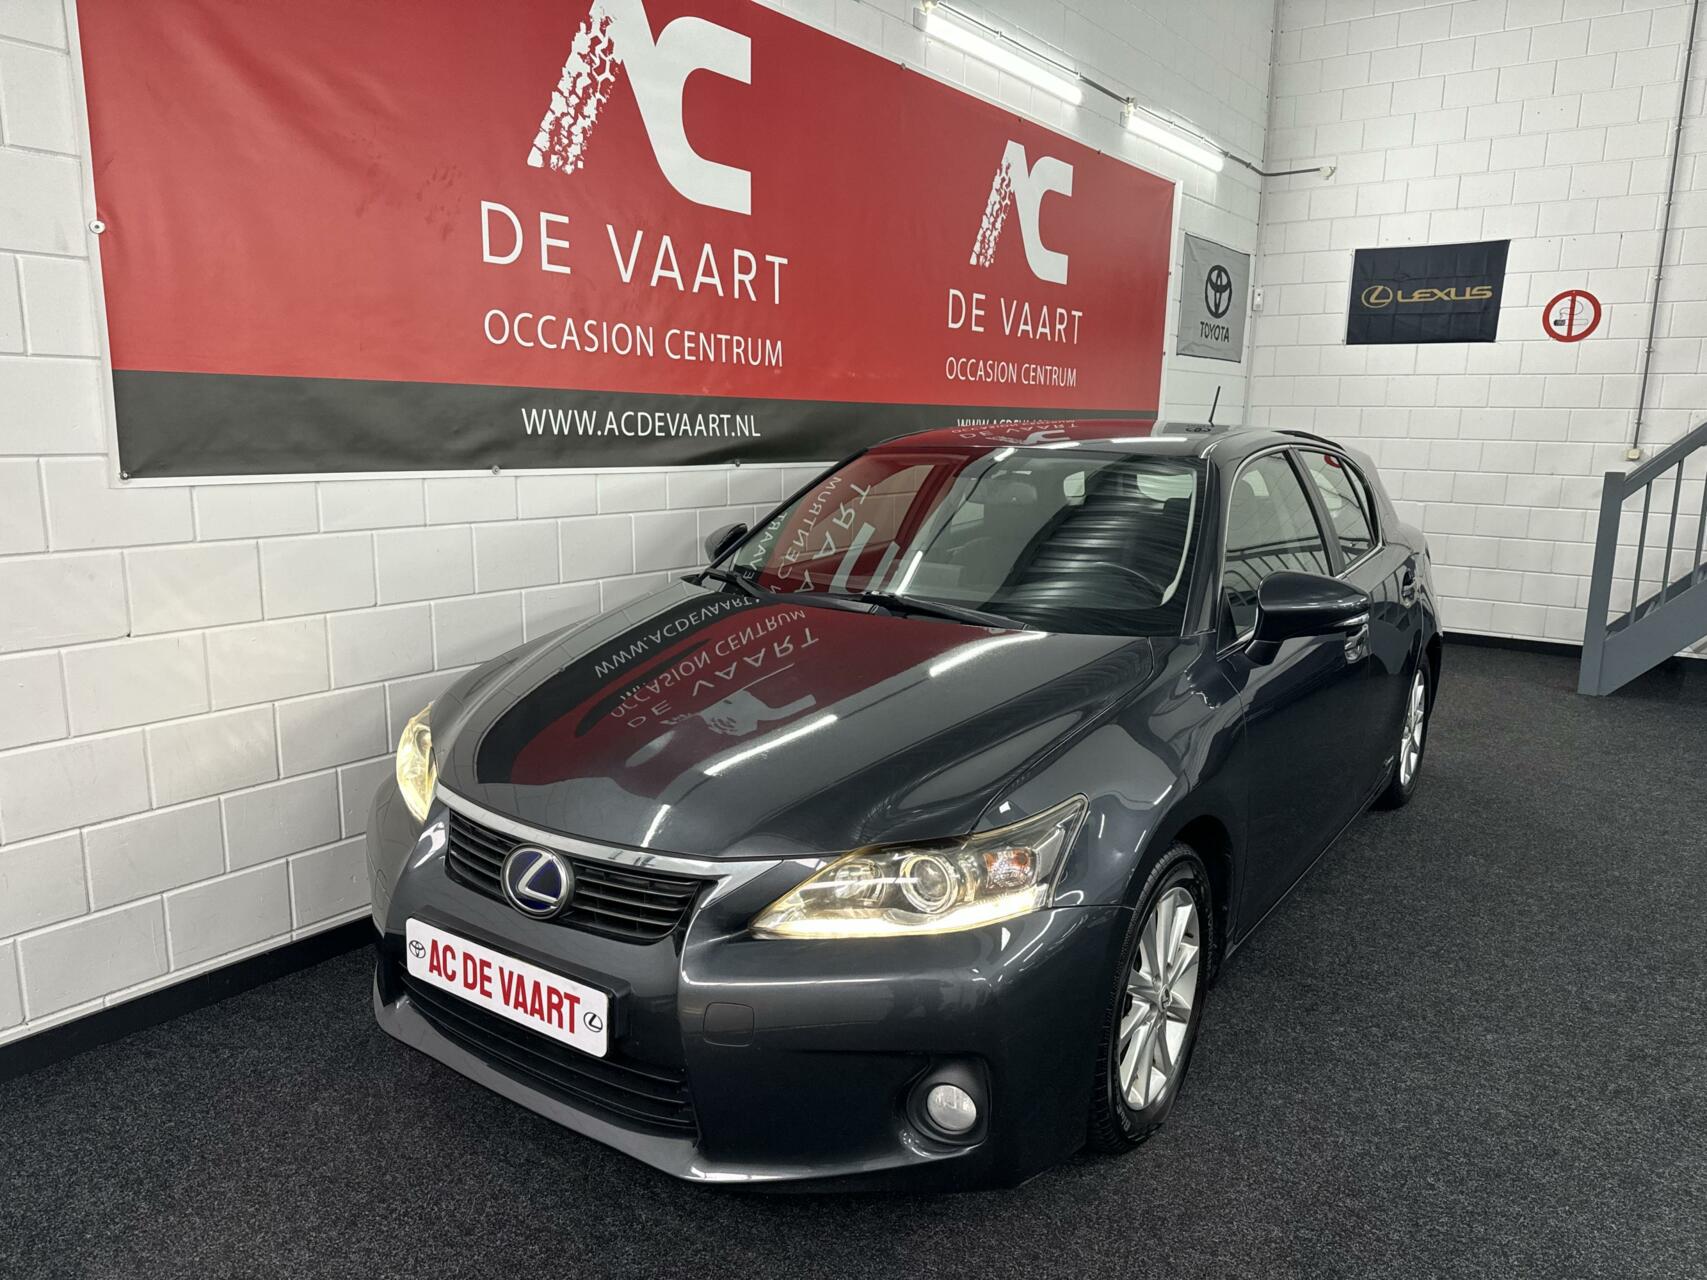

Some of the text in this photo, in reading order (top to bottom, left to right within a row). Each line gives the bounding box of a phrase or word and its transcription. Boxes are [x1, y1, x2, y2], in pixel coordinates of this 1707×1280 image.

[480, 200, 789, 305] DE VAART
[1396, 285, 1493, 303] LEXUS
[483, 308, 784, 368] OCCASION CENTRUM
[947, 288, 1084, 345] DE VAART
[1199, 320, 1231, 344] TOYOTA
[945, 356, 1078, 388] OCCASION CENTRUM
[521, 407, 761, 438] WWW.ACDEVAART.NL
[428, 938, 581, 1034] AC DE VAART
